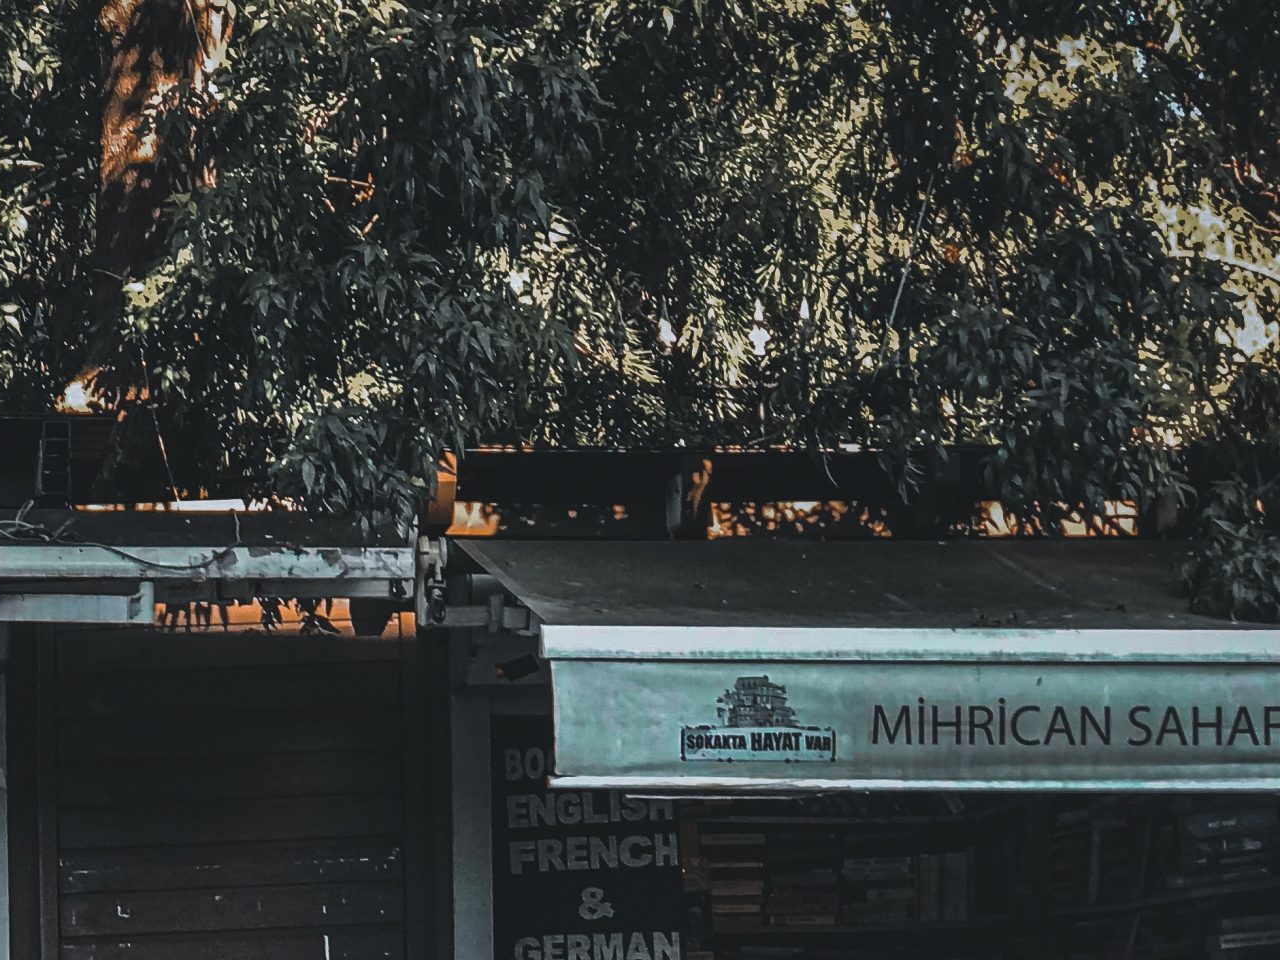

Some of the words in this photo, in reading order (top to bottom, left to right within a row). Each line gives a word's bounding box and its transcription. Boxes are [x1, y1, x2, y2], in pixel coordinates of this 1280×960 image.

[871, 696, 1111, 746] MİHRİCAN
[1128, 704, 1280, 747] SAHAF
[686, 733, 747, 751] SOKAKTA
[750, 732, 802, 752] HAYAT
[805, 735, 832, 752] VAR
[504, 747, 554, 780] BO
[507, 791, 674, 828] ENGLISH
[508, 834, 679, 875] FRENCH
[577, 886, 616, 921] &
